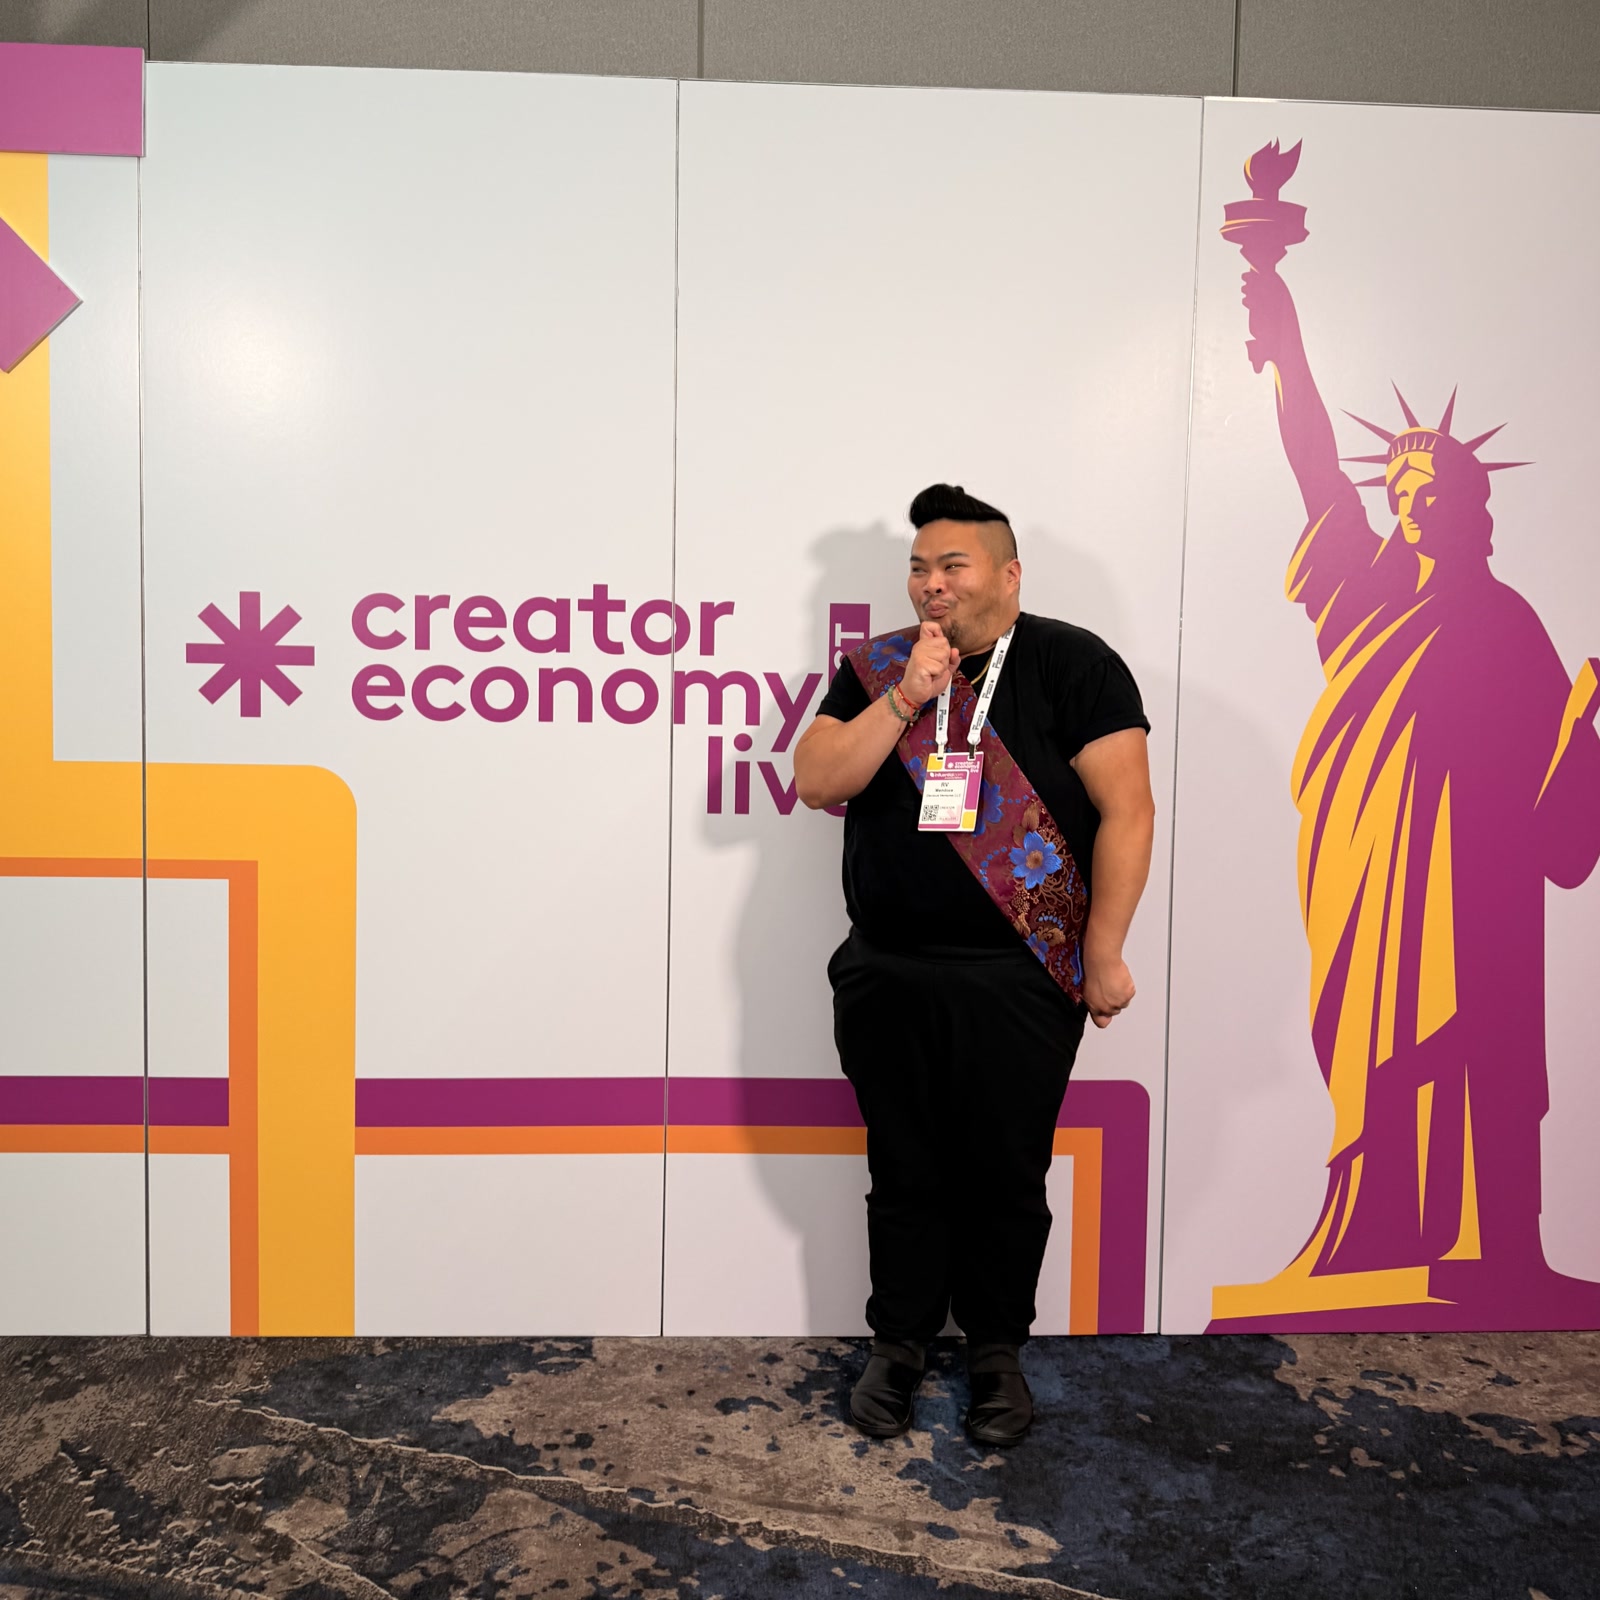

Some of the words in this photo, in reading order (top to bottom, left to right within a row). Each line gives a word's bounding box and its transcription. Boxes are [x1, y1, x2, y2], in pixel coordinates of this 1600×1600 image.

[351, 583, 735, 656] creator
[351, 663, 823, 753] economy
[707, 733, 847, 817] liv
